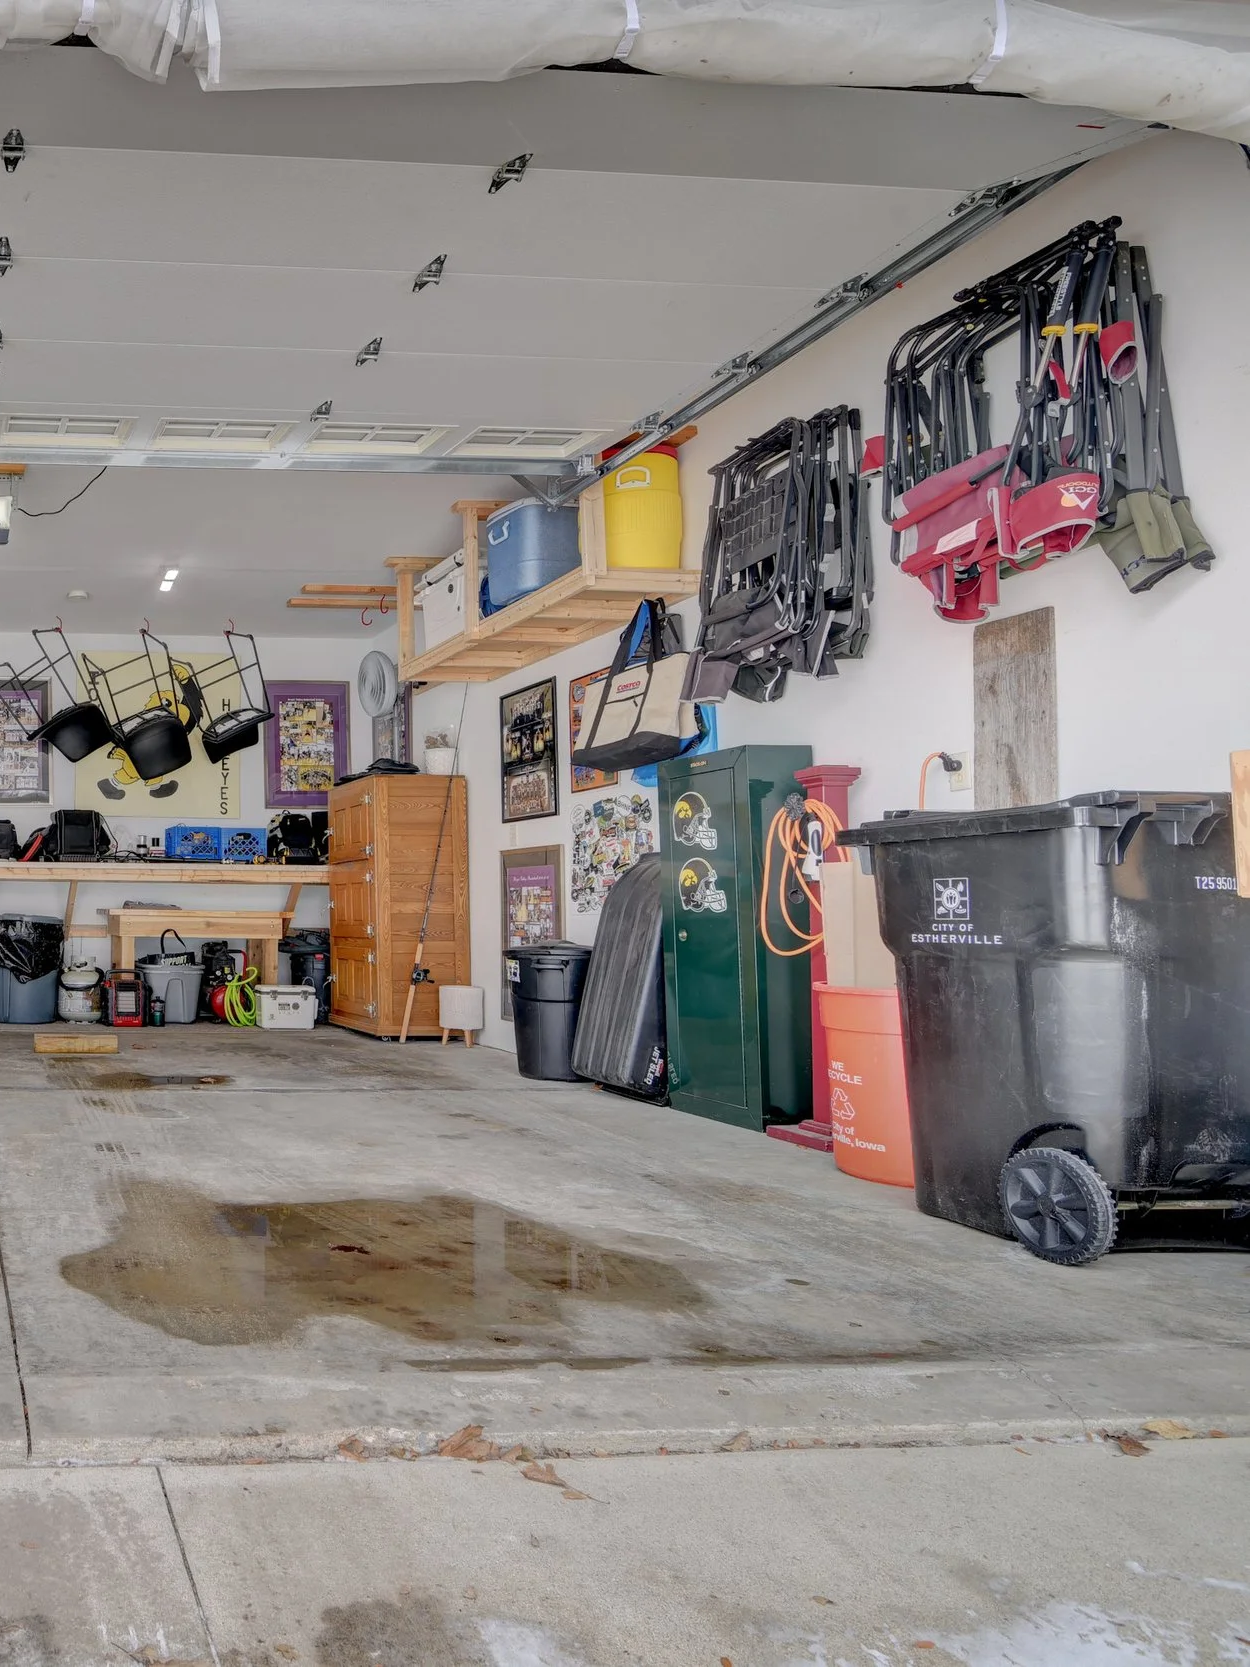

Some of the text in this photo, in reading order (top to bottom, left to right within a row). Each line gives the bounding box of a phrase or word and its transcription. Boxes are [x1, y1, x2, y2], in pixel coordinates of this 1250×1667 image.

[1069, 486, 1097, 494] GCI
[617, 681, 641, 691] COSTCO
[220, 698, 231, 815] HEYES
[932, 923, 974, 931] CITY OF
[911, 933, 1003, 945] ESTHERVILLE
[651, 1046, 661, 1064] JET
[831, 1060, 844, 1071] WE
[643, 1062, 656, 1085] SLED
[827, 1069, 862, 1085] ECYCLE
[844, 1126, 854, 1135] of
[855, 1138, 886, 1152] Iowa
